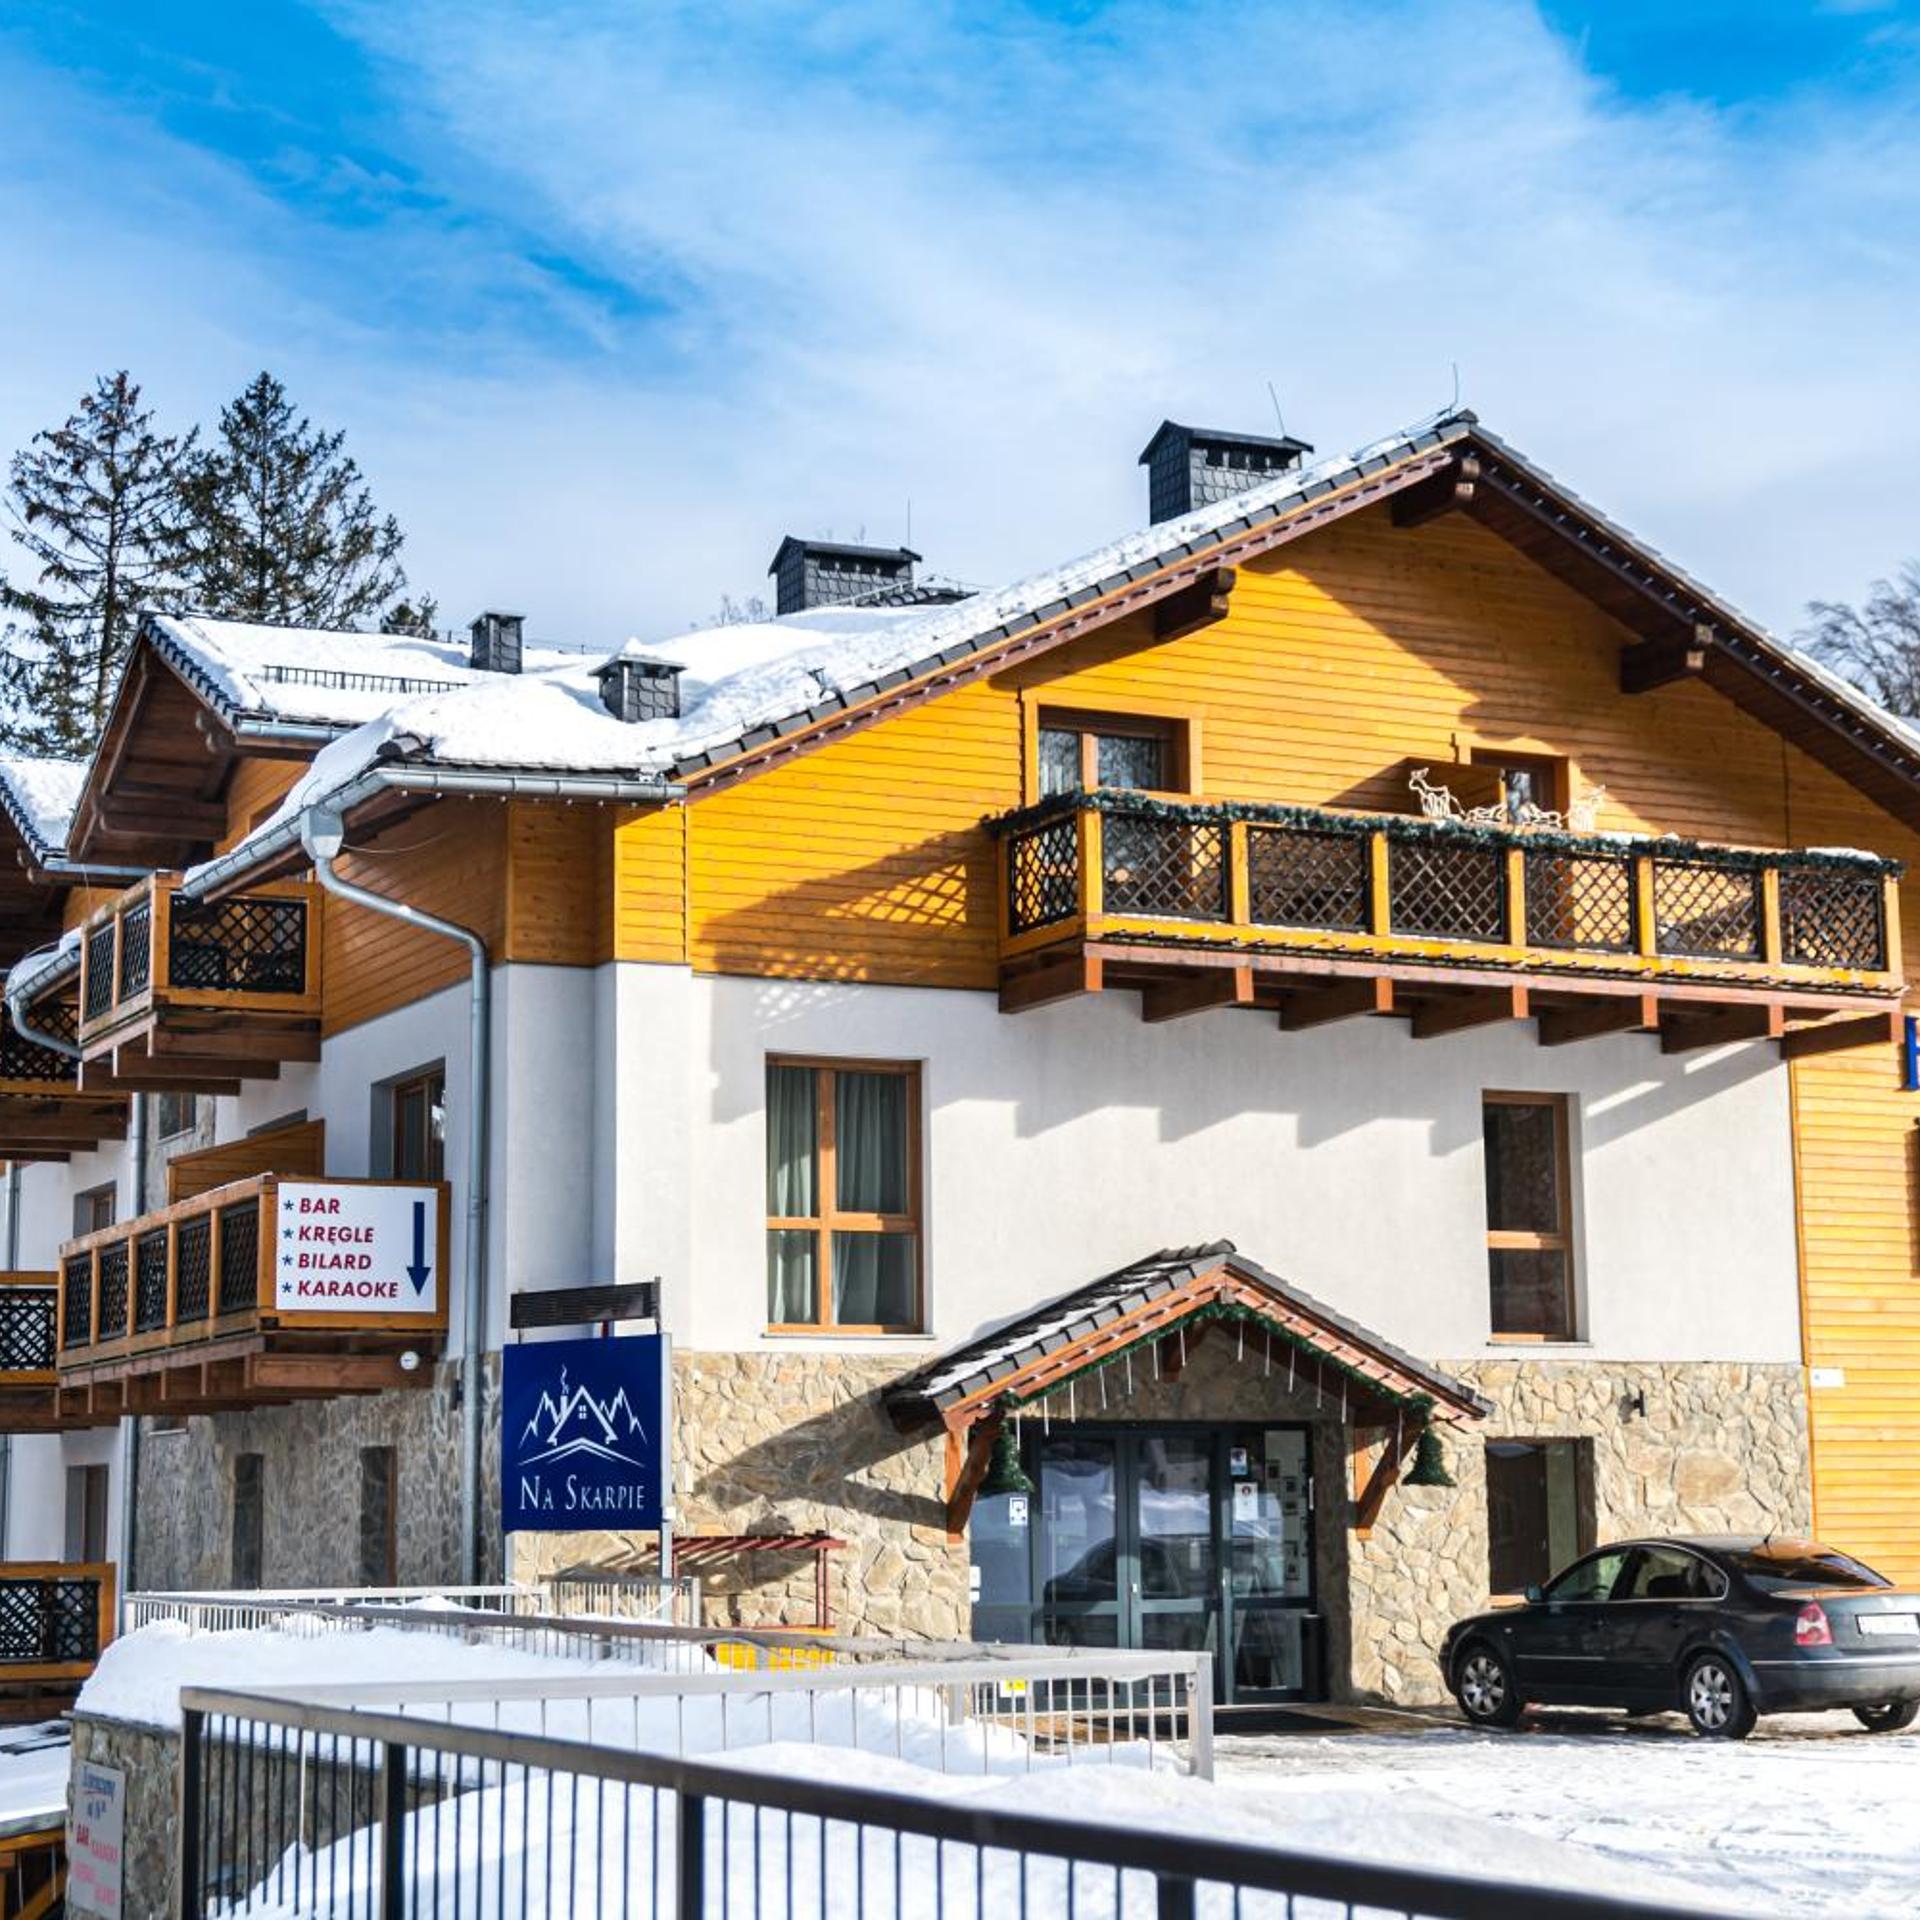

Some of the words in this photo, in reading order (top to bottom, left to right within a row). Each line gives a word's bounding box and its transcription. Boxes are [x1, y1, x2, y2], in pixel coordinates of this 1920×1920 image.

[299, 1198, 341, 1214] BAR
[299, 1226, 375, 1245] KRĘGLE
[298, 1253, 372, 1270] BILARD
[297, 1281, 399, 1298] KARAOKE
